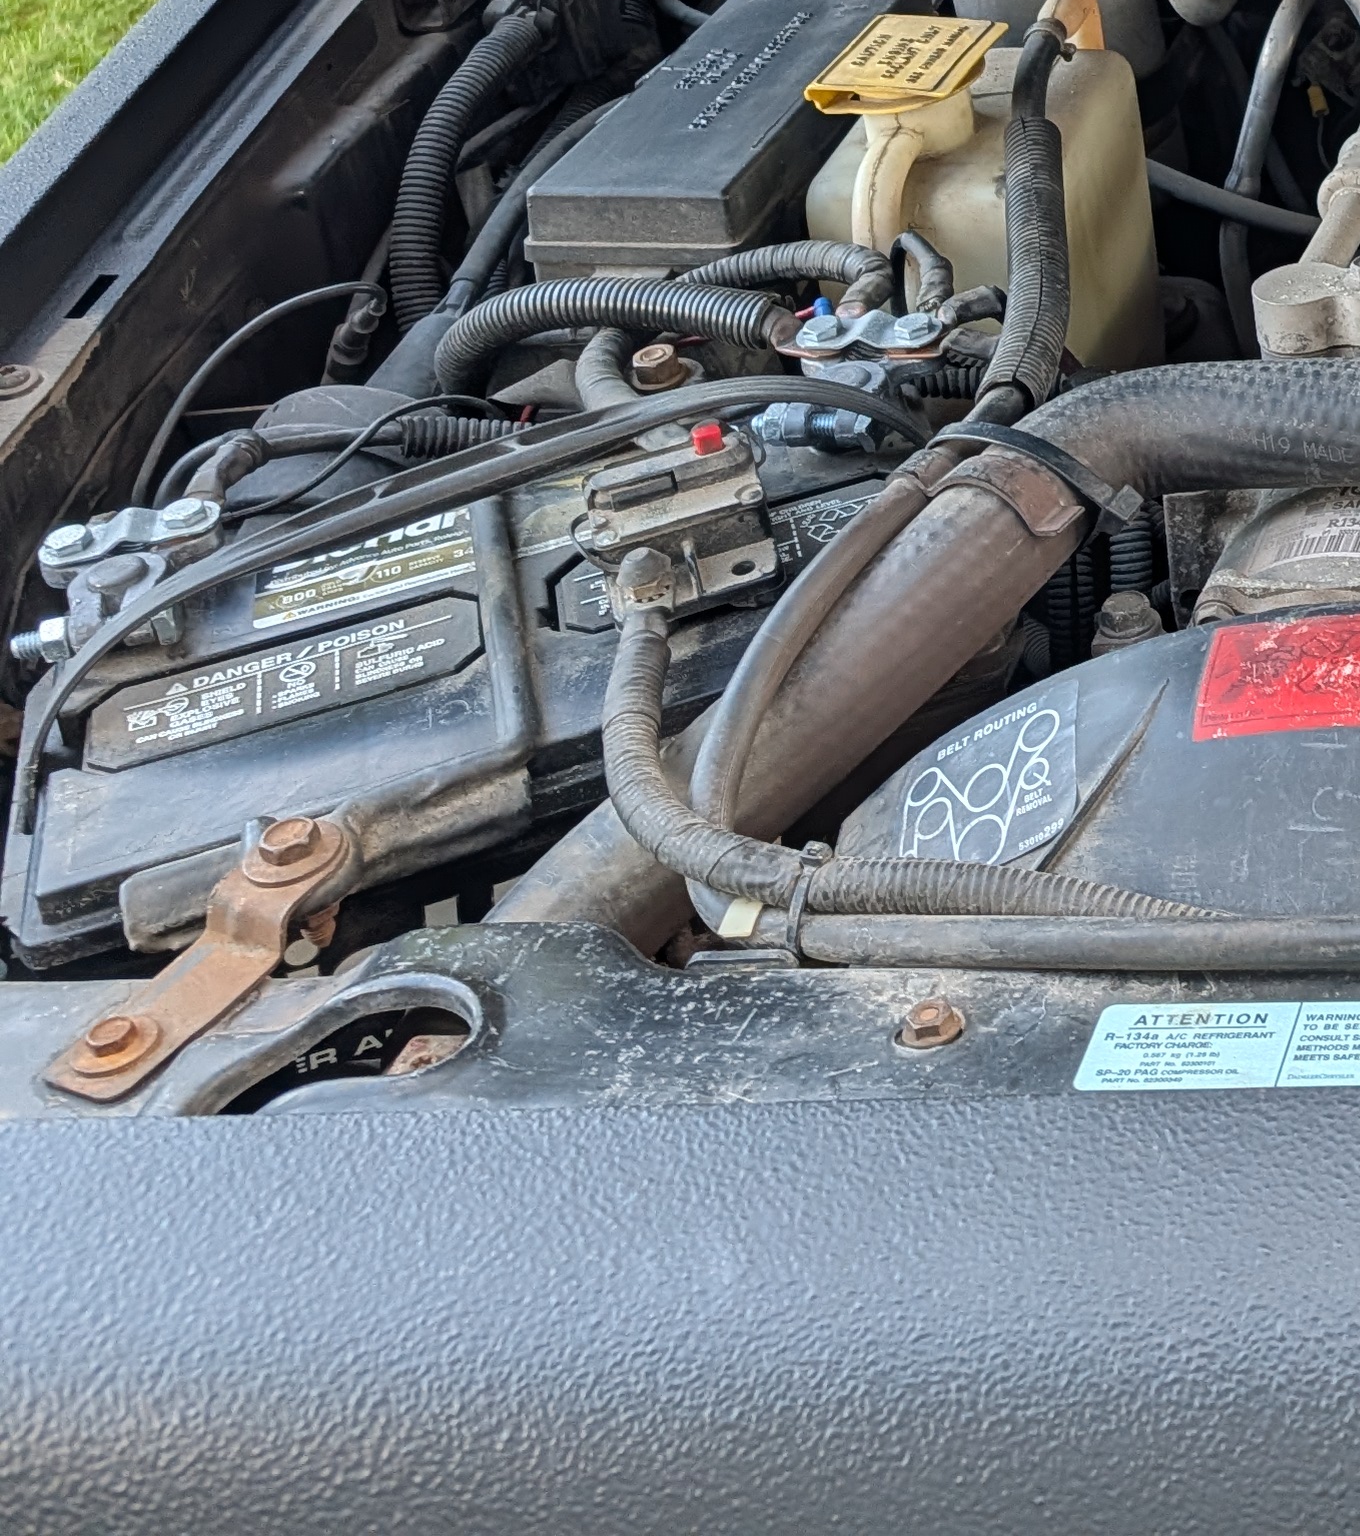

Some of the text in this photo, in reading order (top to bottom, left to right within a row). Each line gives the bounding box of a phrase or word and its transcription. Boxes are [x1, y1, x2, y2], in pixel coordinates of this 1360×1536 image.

[282, 589, 316, 605] 800
[375, 566, 402, 579] 110
[297, 596, 360, 616] WARNING:
[417, 638, 445, 652] ACID
[193, 652, 292, 688] DANGER
[318, 619, 405, 652] POISON
[937, 702, 1037, 761] BELT ROUTING
[1024, 789, 1043, 803] BELT
[1015, 794, 1053, 816] REMOVAL
[1019, 817, 1064, 851] 53010299
[1133, 1013, 1269, 1026] ATTENTION
[1323, 1023, 1339, 1031] BE
[1104, 1031, 1276, 1041] R-134a A/C REFRIGERANT
[1300, 1034, 1350, 1042] CONSULT
[1114, 1042, 1163, 1050] FACTORY
[1134, 1068, 1158, 1076] PAG
